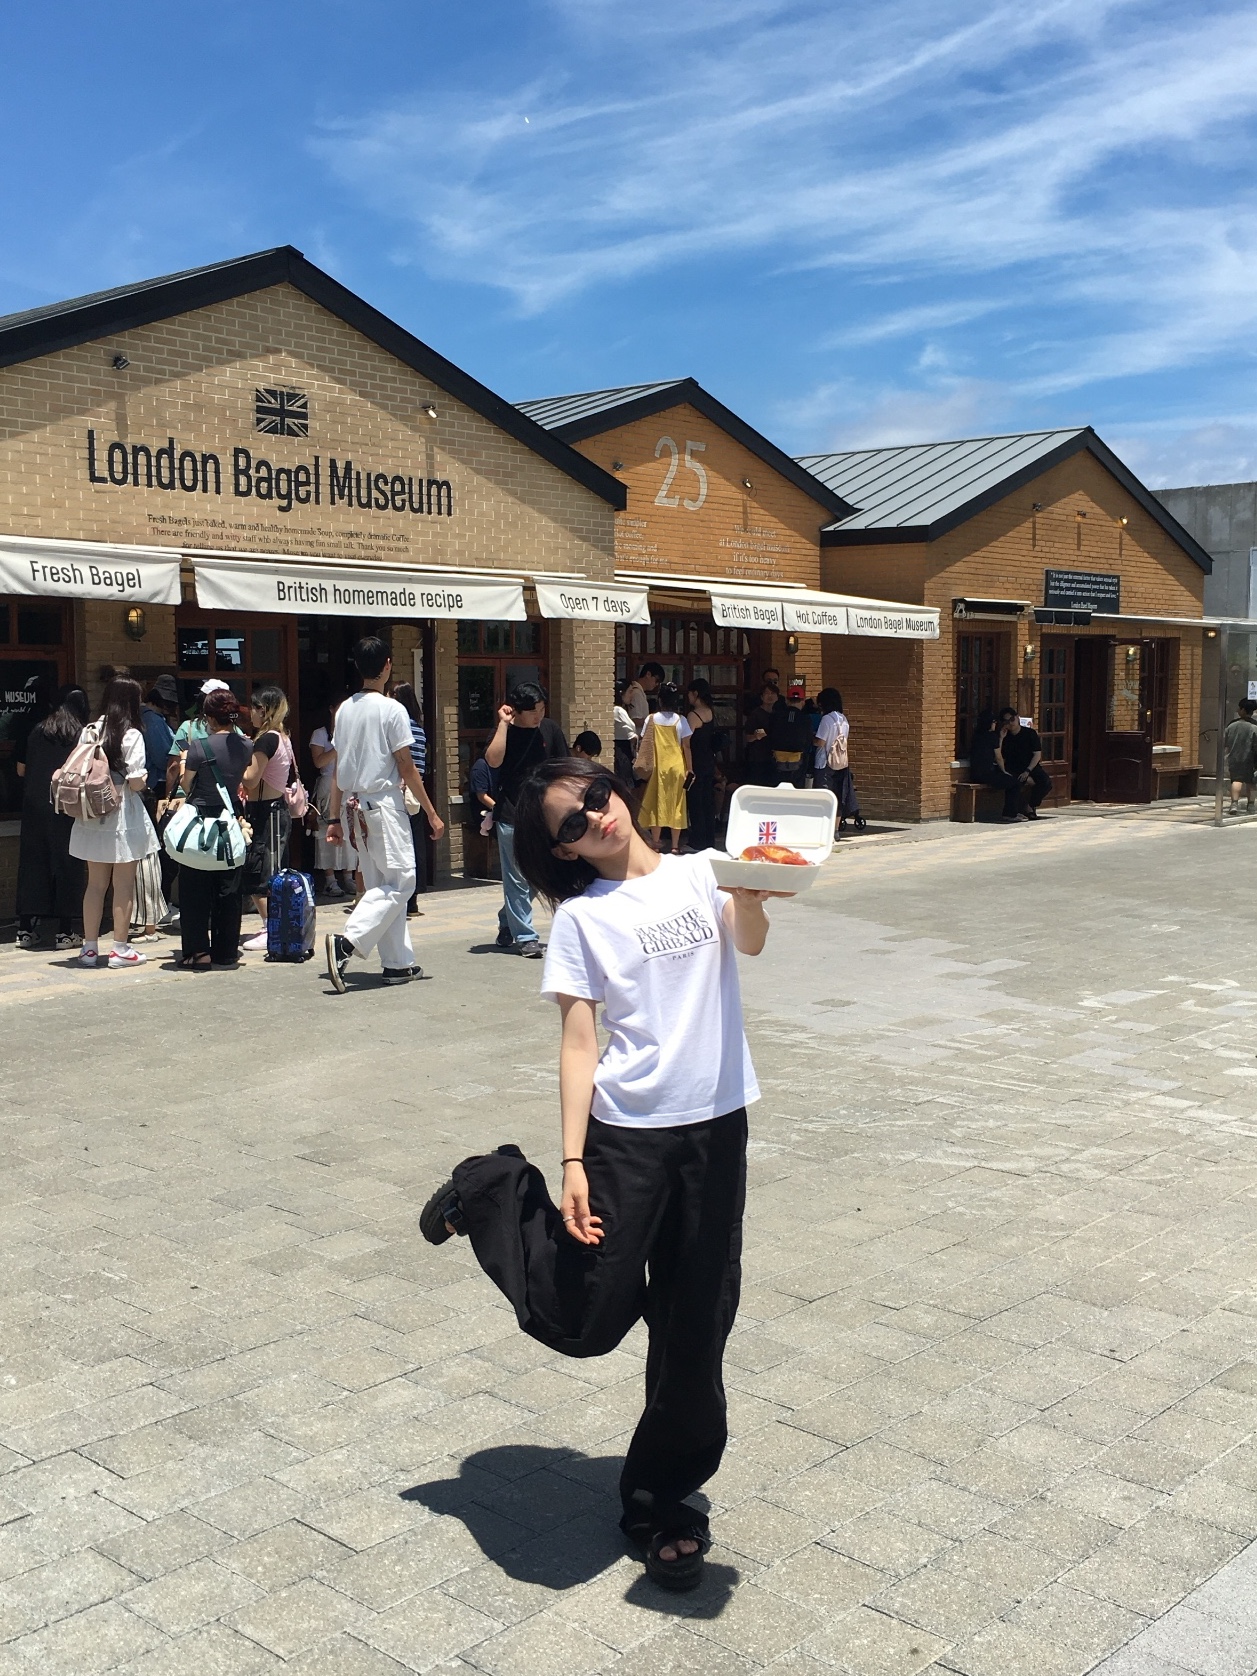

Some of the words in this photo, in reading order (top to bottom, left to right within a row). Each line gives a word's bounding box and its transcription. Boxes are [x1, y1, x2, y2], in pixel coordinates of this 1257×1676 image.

[88, 430, 221, 495] London
[233, 447, 320, 512] Bagel
[330, 458, 452, 517] Museum
[654, 436, 708, 510] 25
[147, 514, 166, 524] Fresh
[168, 516, 190, 526] Bagels
[192, 518, 204, 528] just
[206, 519, 228, 529] baked,
[228, 522, 246, 530] warm
[248, 523, 260, 531] and
[260, 524, 282, 534] healthy
[284, 526, 316, 536] homemade
[318, 528, 334, 538] Soup,
[335, 531, 366, 541] completely
[367, 532, 390, 541] dramatic
[151, 527, 171, 536] There
[185, 530, 210, 540] friendly
[225, 534, 241, 543] witty
[243, 535, 256, 543] staff
[258, 536, 271, 544] who
[272, 536, 294, 546] always
[295, 538, 314, 548] having
[327, 540, 342, 548] small
[358, 542, 374, 551] Thank
[376, 545, 386, 553] you
[395, 545, 409, 553] much
[726, 538, 748, 549] London
[733, 552, 740, 562] if
[760, 555, 776, 567] heavy
[30, 560, 84, 584] Fresh
[88, 565, 142, 592] Bagel
[277, 580, 327, 603] British
[333, 584, 416, 606] homemade
[420, 590, 463, 612] recipe
[560, 593, 589, 612] Open
[592, 596, 598, 611] 7
[604, 596, 630, 616] days
[721, 603, 751, 619] British
[753, 606, 778, 624] Bagel
[795, 610, 810, 624] Hot
[812, 611, 838, 626] Coffee
[856, 614, 882, 629] London
[884, 616, 904, 633] Bagel
[905, 617, 934, 632] Museum
[5, 691, 36, 703] MUSEUM
[643, 926, 713, 954] GIRBAUD
[672, 951, 694, 960] PARIS
